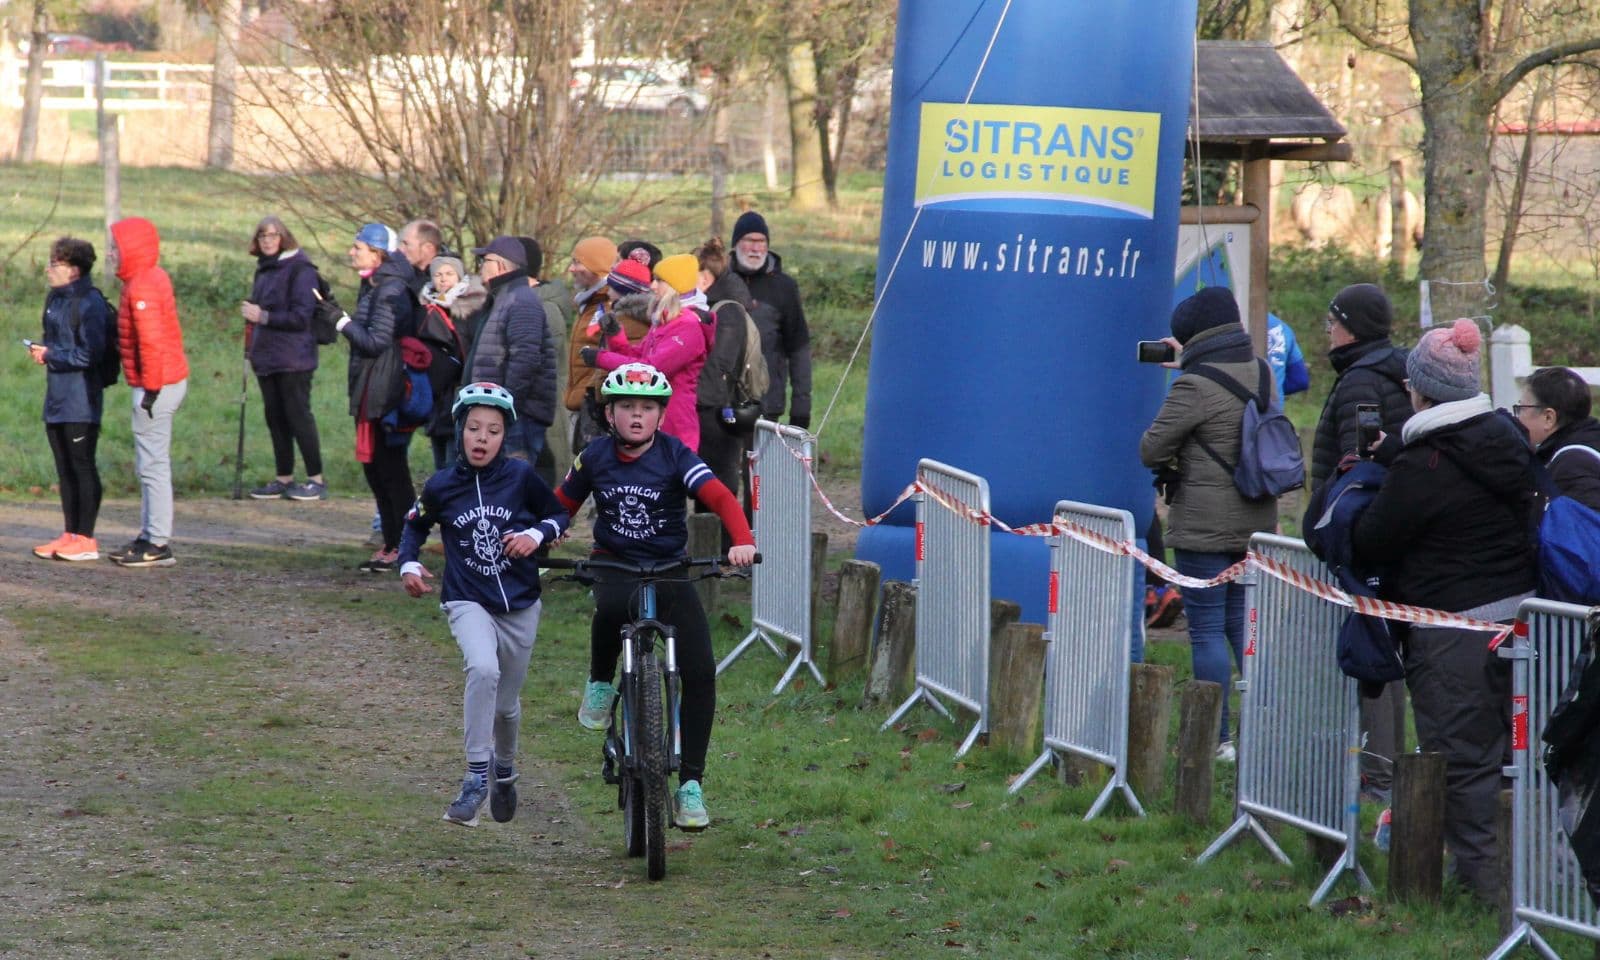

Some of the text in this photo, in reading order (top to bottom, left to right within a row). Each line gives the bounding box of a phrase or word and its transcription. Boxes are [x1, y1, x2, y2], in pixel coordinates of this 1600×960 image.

[945, 118, 1134, 161] SITRANS
[942, 160, 1130, 185] LOGISTIQUE
[922, 233, 1141, 278] www.sitrans.fr
[453, 505, 512, 528] TRIATHLON
[610, 522, 656, 539] CADEMY
[465, 557, 511, 576] ACADEMY
